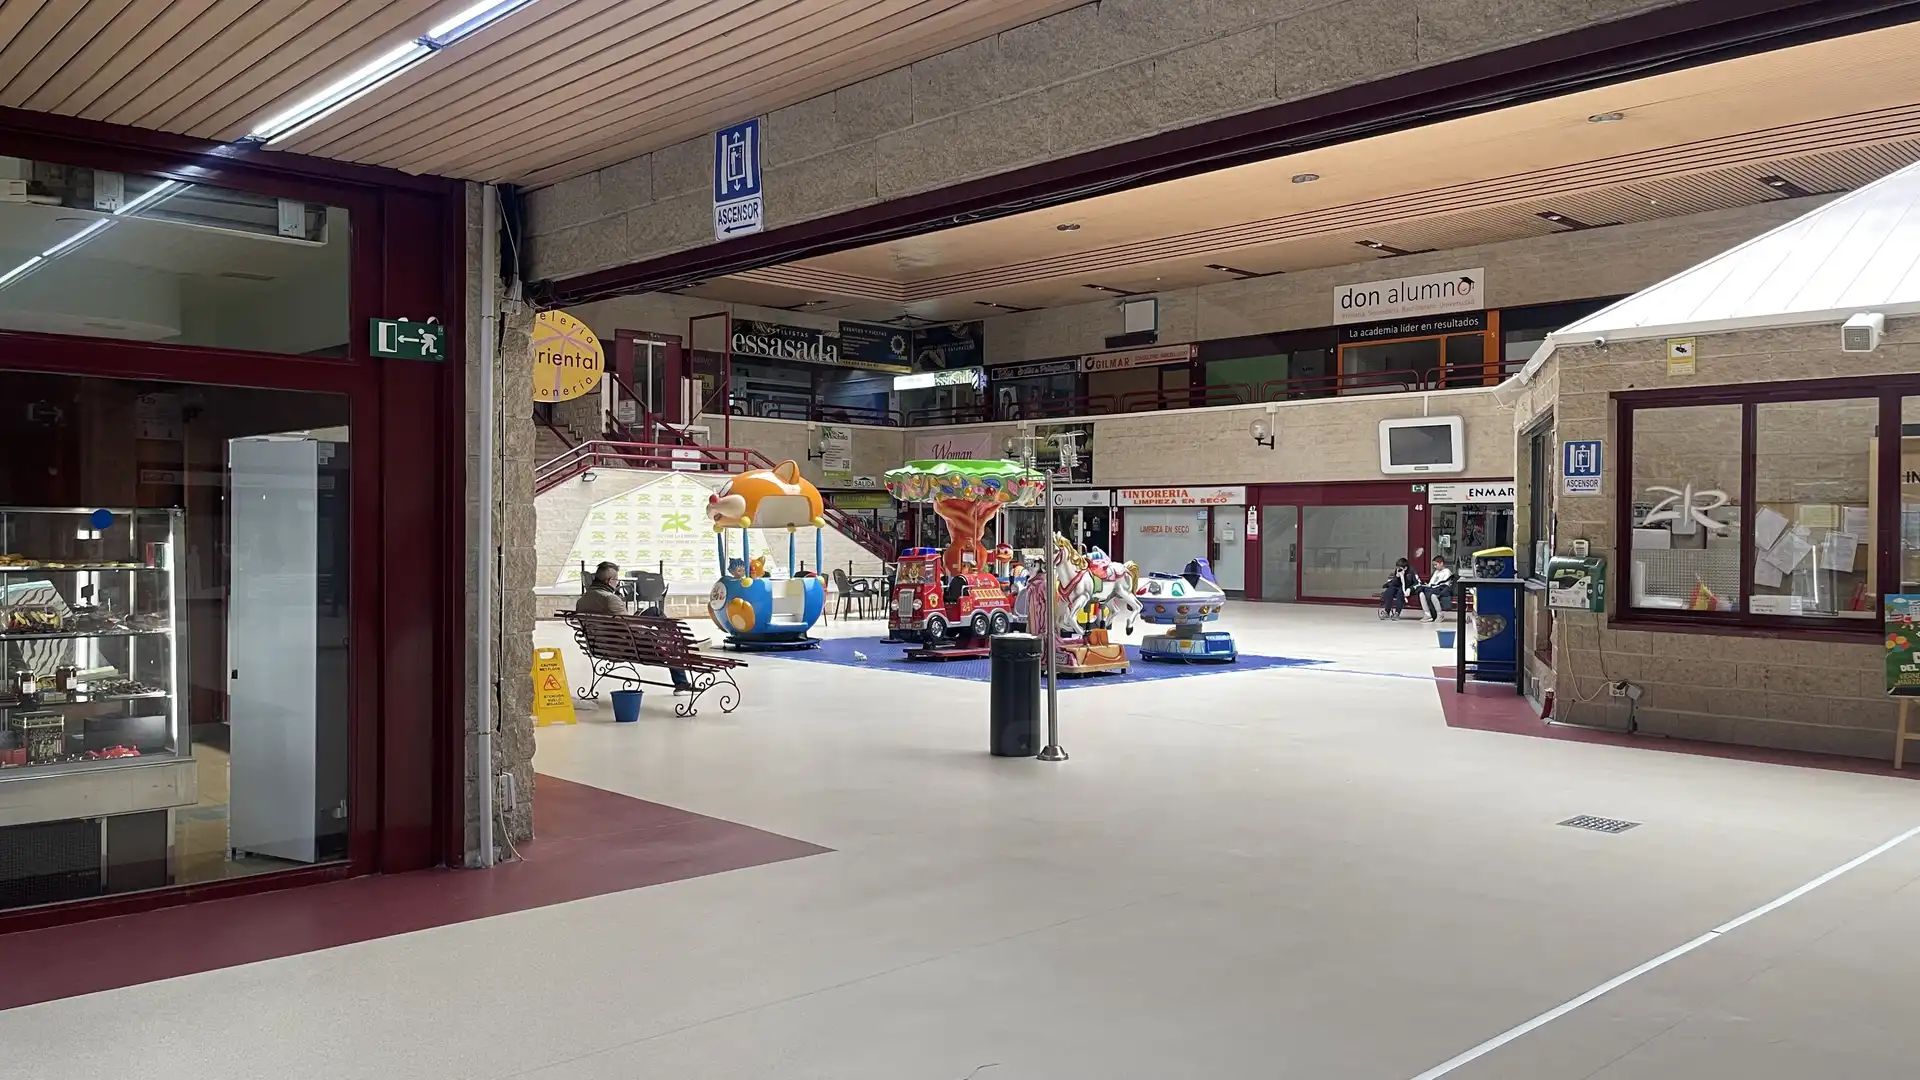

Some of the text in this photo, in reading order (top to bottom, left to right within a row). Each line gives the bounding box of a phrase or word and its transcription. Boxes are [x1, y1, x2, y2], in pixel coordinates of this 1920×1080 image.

[718, 202, 759, 226] ASCENSOR
[1341, 276, 1475, 309] don alumno
[1367, 307, 1399, 316] Secundaria
[1401, 303, 1437, 312] Bachillerato
[1439, 299, 1475, 309] Universidad
[1349, 316, 1479, 338] La academia líder en resultados
[732, 332, 839, 364] essasada
[535, 348, 598, 370] riental
[1096, 357, 1130, 369] GILMAR
[532, 376, 593, 397] onería
[931, 441, 973, 460] Woman
[1566, 479, 1599, 488] ASCENSOR
[1122, 489, 1189, 499] TINTORERIA
[1140, 525, 1190, 533] LIMPIEZA EN SECO
[1900, 664, 1919, 672] DEL
